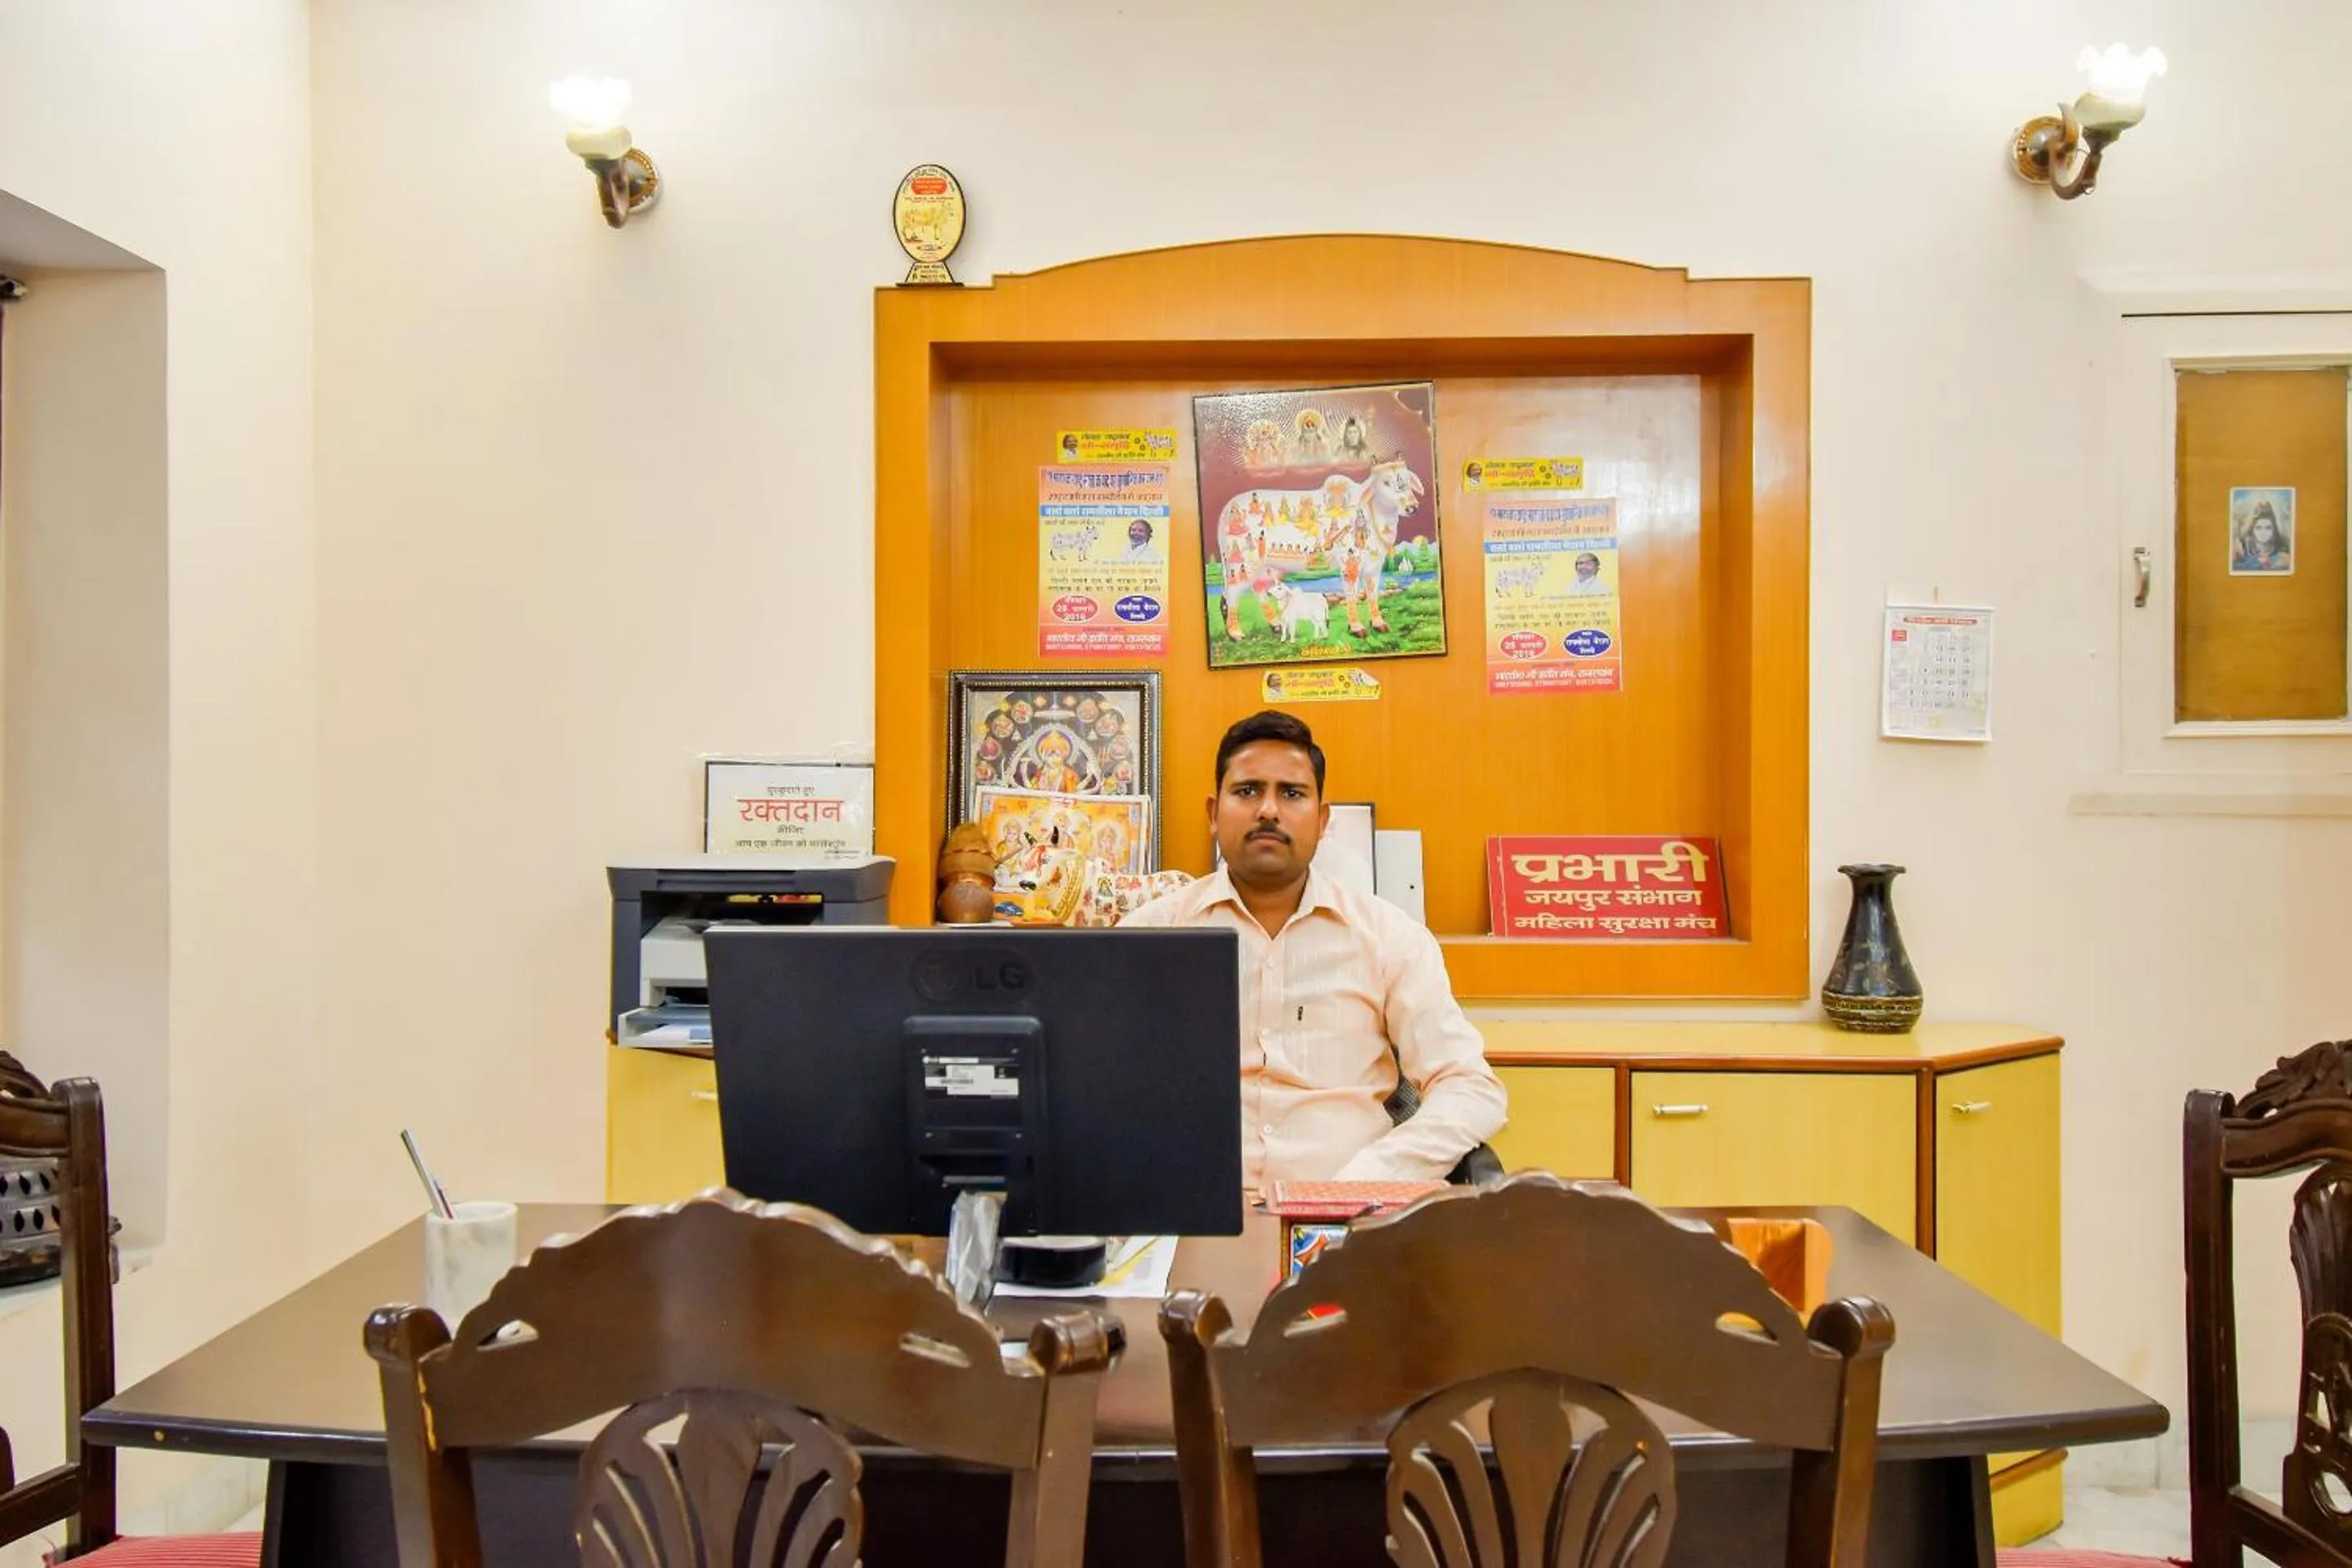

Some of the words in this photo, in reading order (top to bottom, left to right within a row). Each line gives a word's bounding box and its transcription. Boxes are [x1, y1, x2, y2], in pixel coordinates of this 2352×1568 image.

[737, 798, 844, 823] रक्तदान
[1511, 840, 1709, 884] प्रभारी
[1523, 889, 1613, 911] जयपुर
[1615, 885, 1704, 906] संभाग
[1515, 912, 1596, 929] महिला
[1597, 915, 1672, 933] सुरक्षा
[1674, 913, 1717, 930] मंच
[975, 960, 1025, 990] LG
